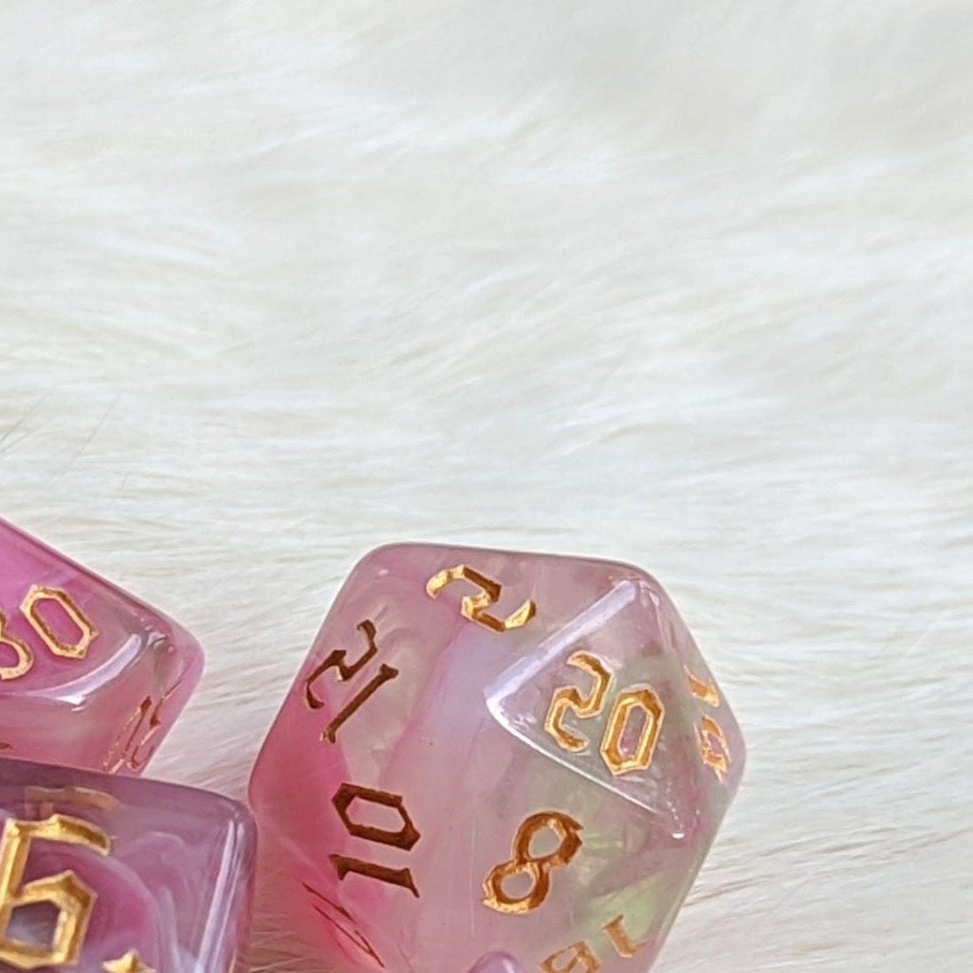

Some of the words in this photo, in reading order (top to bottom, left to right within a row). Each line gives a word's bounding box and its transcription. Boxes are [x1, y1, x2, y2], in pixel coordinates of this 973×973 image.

[427, 564, 537, 632] 2
[544, 650, 665, 777] 20
[328, 782, 421, 898] 10
[481, 810, 583, 914] 8
